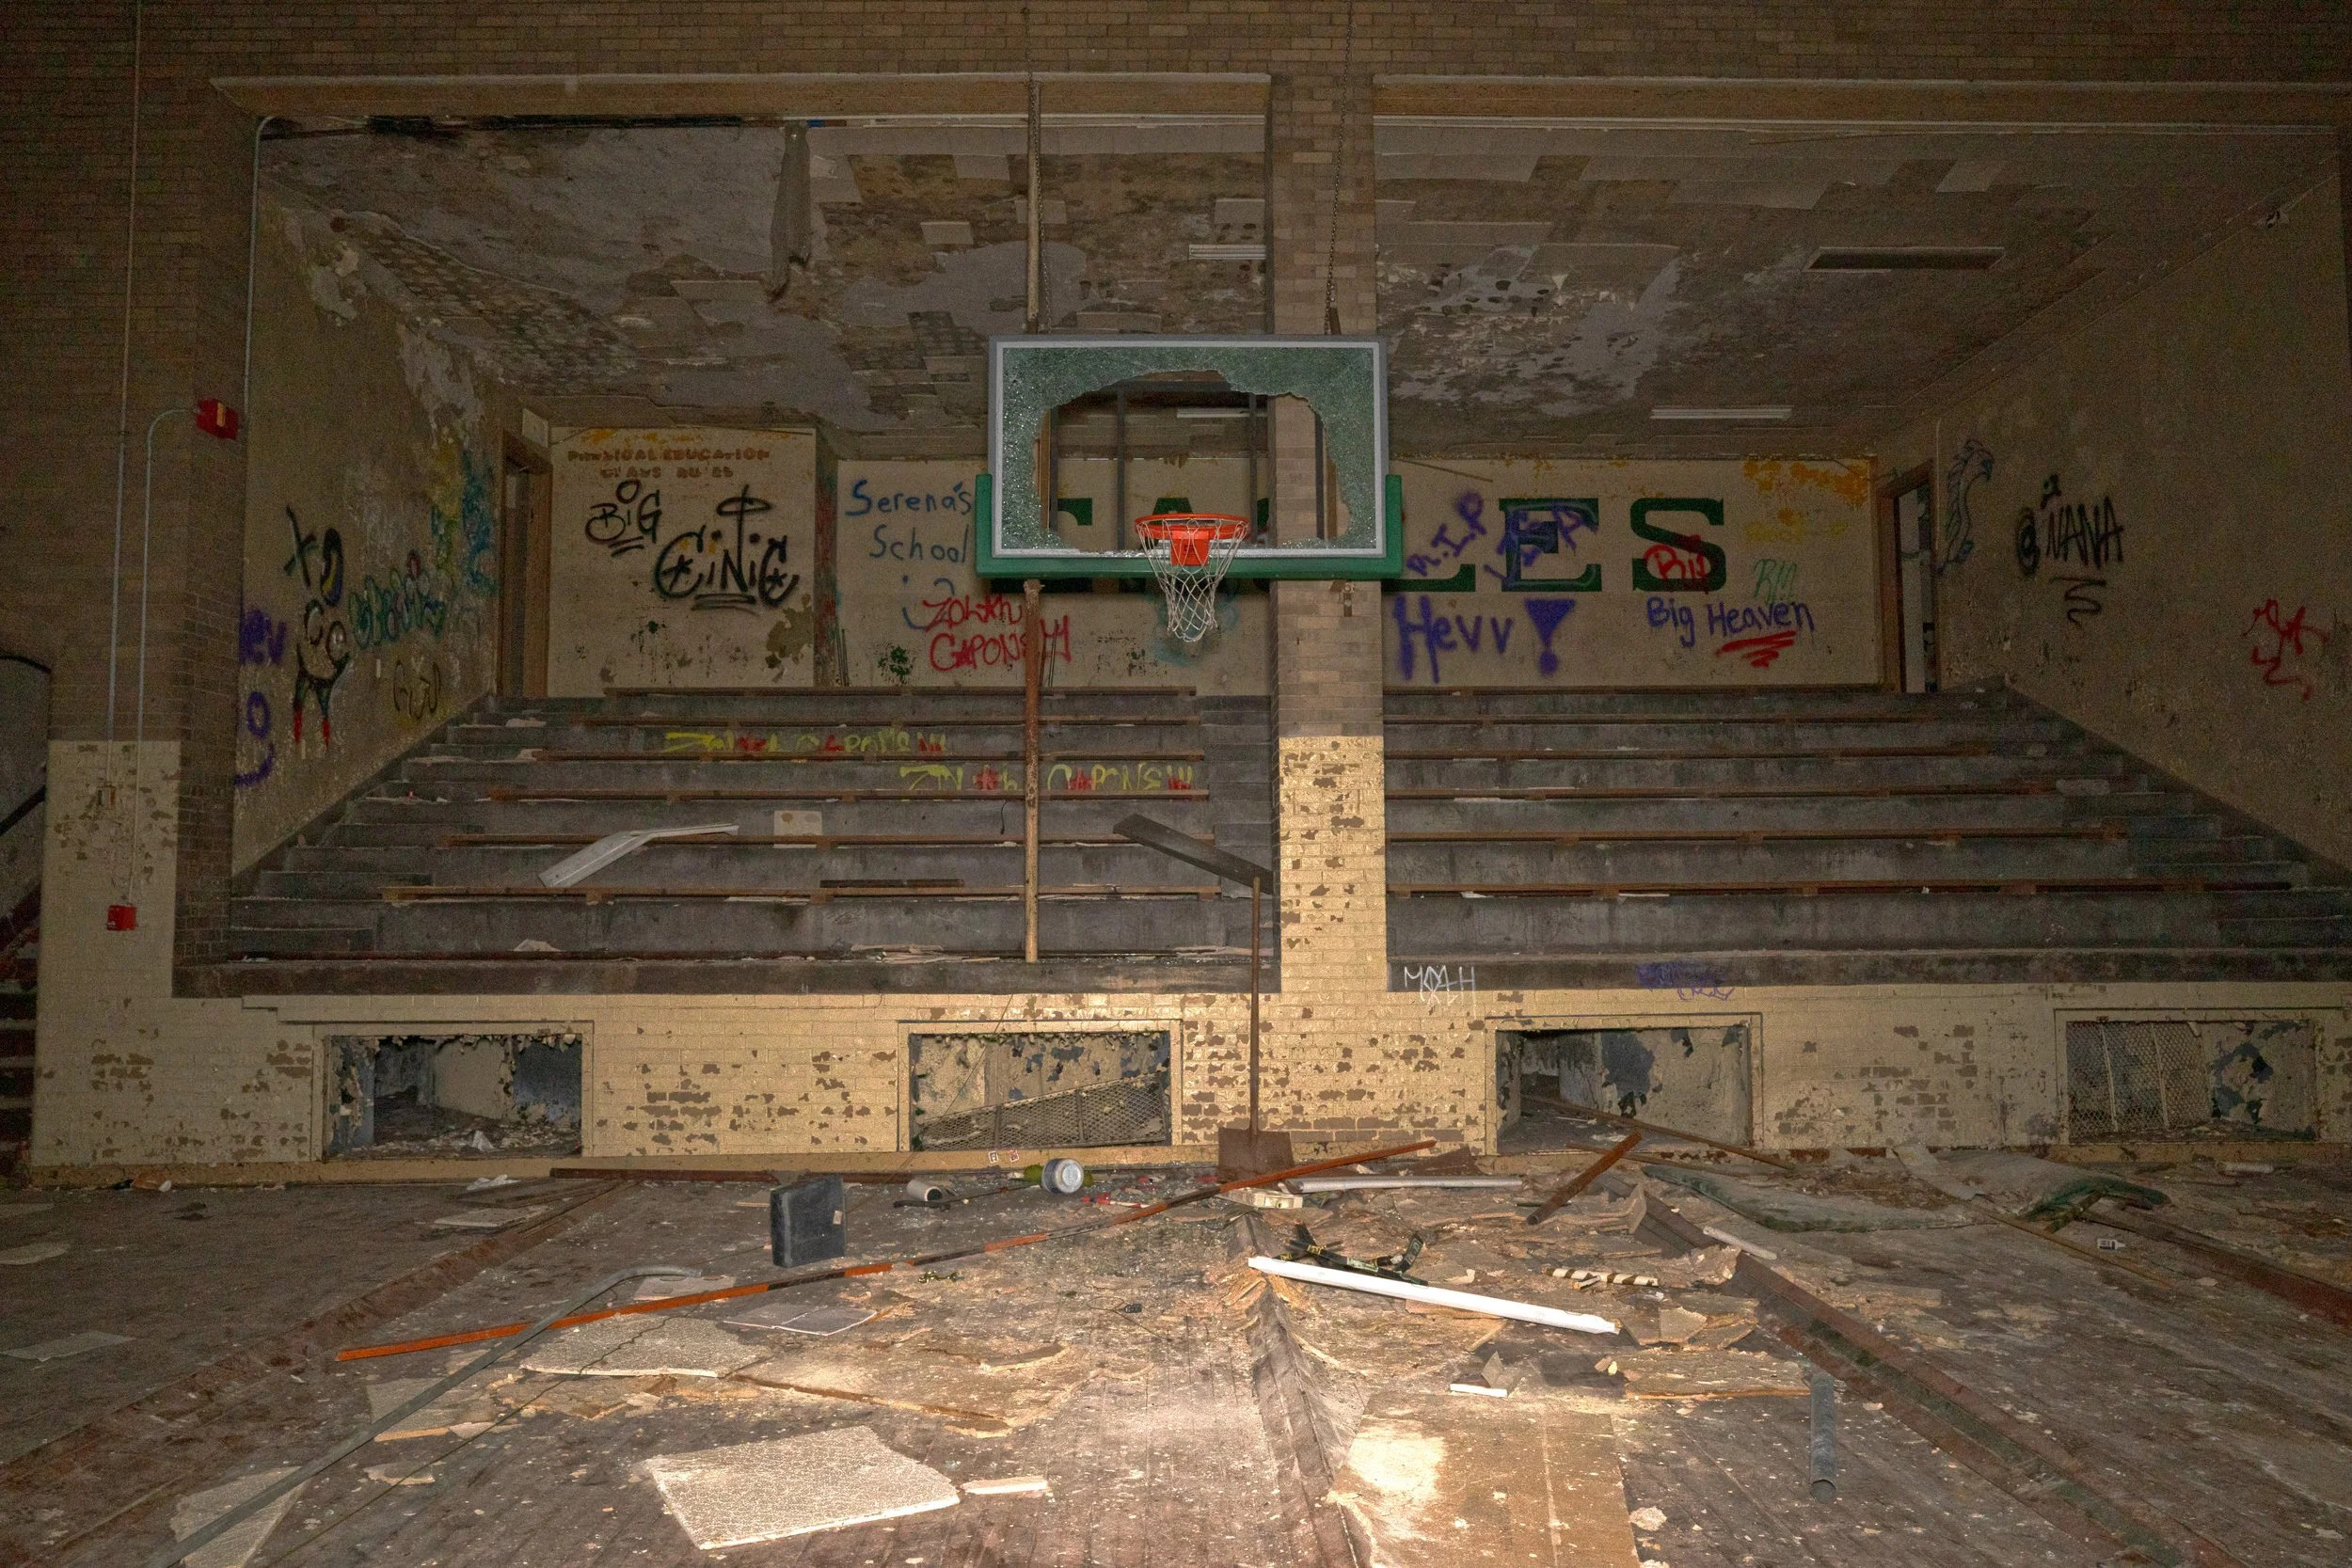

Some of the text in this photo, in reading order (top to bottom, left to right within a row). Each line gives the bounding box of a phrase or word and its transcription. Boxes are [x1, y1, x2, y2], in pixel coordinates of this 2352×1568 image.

[599, 466, 735, 479] CASS RUES
[846, 479, 972, 517] Serena's
[868, 524, 970, 564] School
[1646, 596, 1816, 648] Big Heaven
